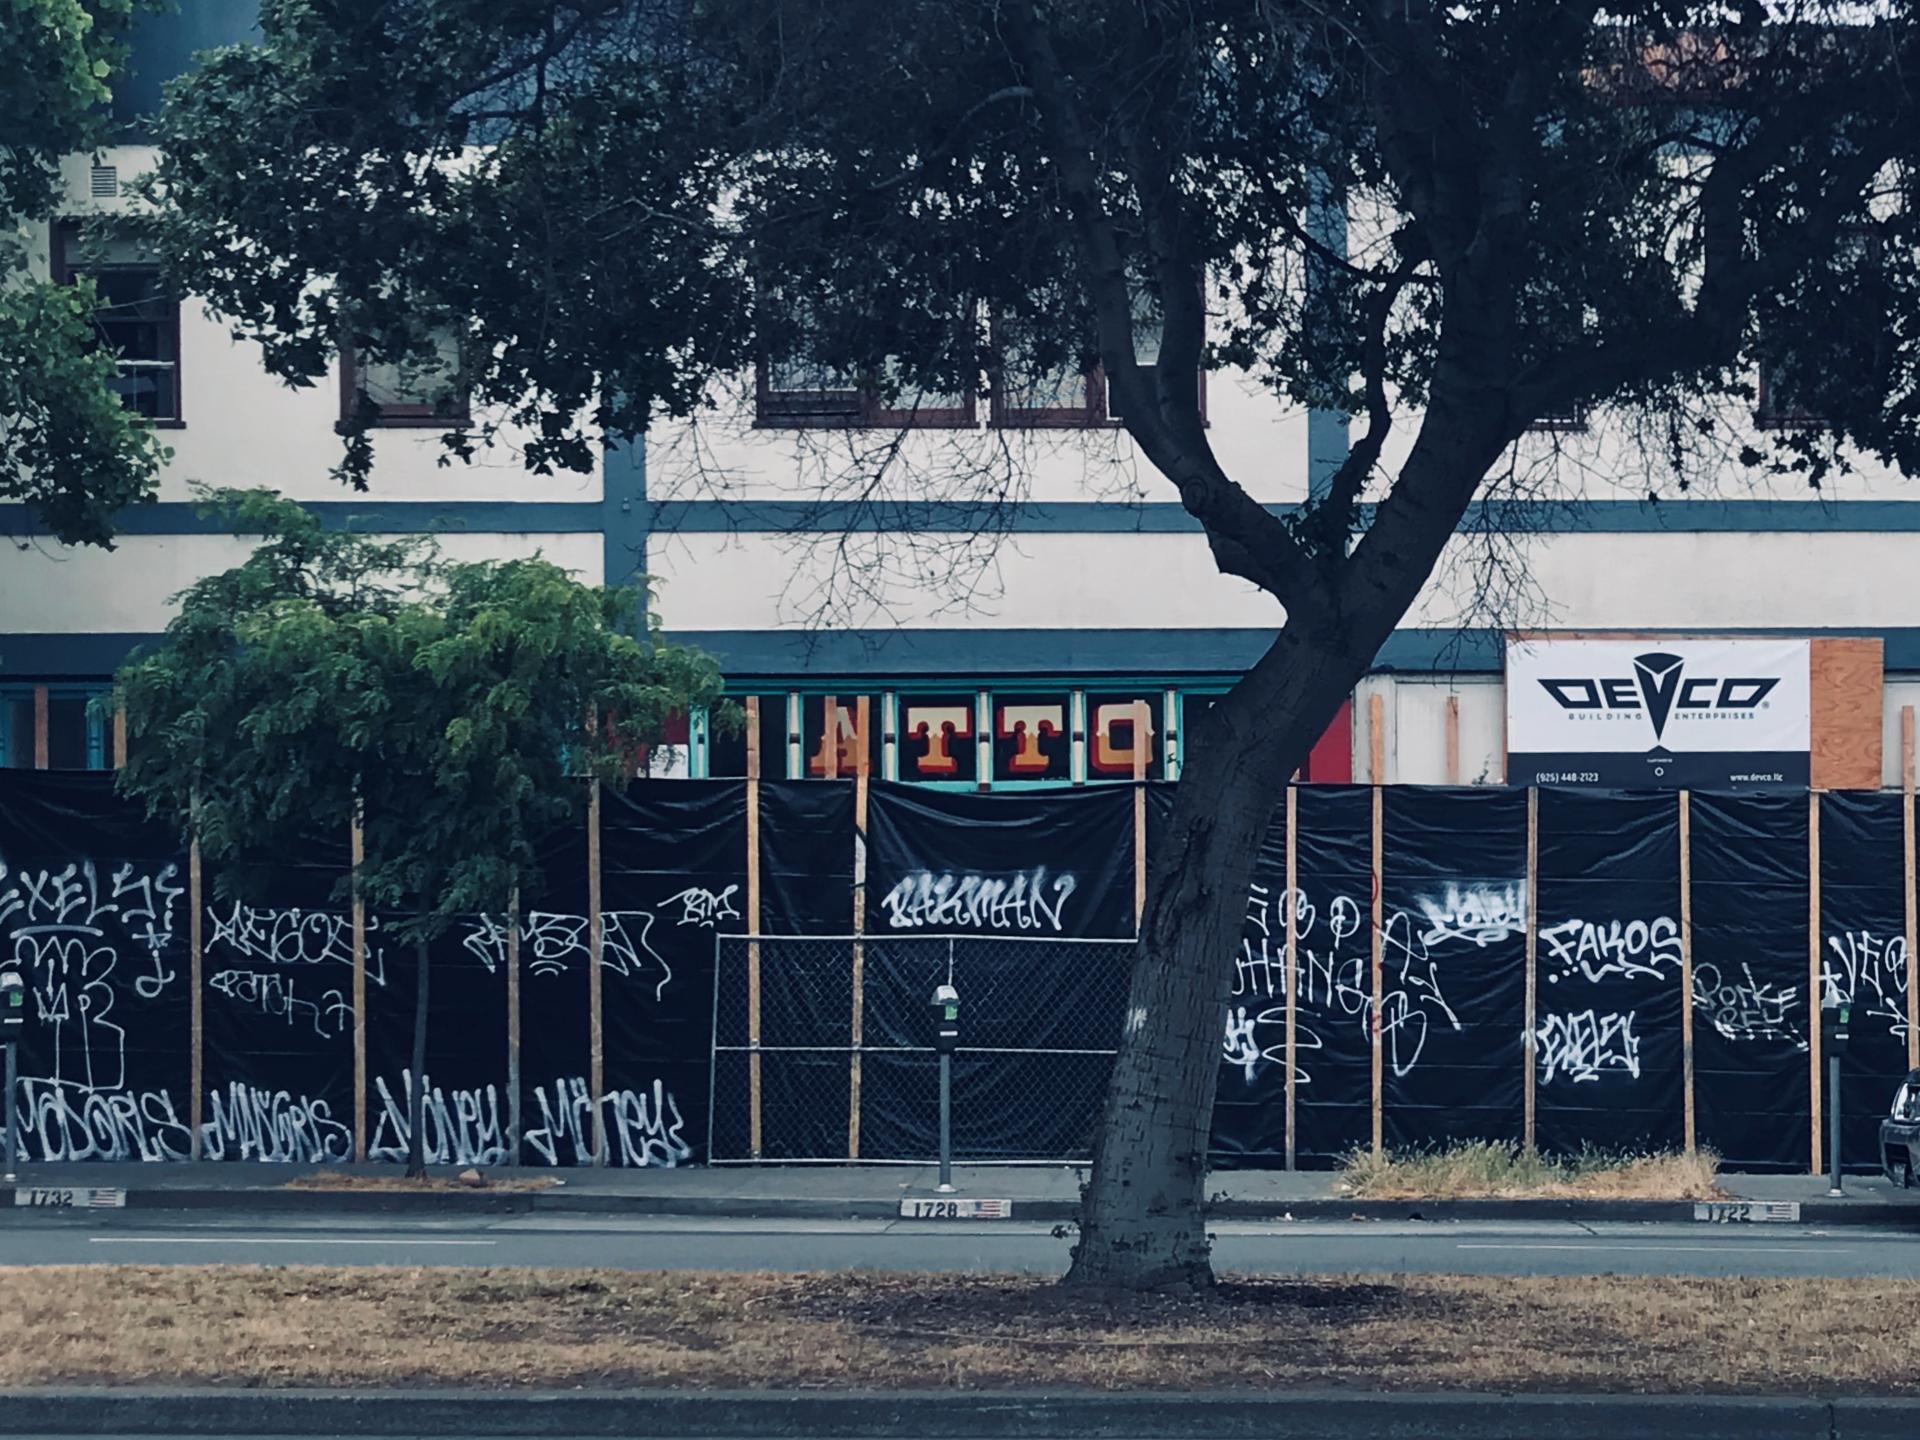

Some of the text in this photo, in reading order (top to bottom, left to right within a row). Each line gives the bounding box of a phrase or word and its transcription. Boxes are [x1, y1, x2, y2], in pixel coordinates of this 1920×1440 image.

[1675, 712, 1755, 720] ENTERPRISES
[30, 1190, 73, 1206] 1732
[915, 1202, 958, 1218] 1728
